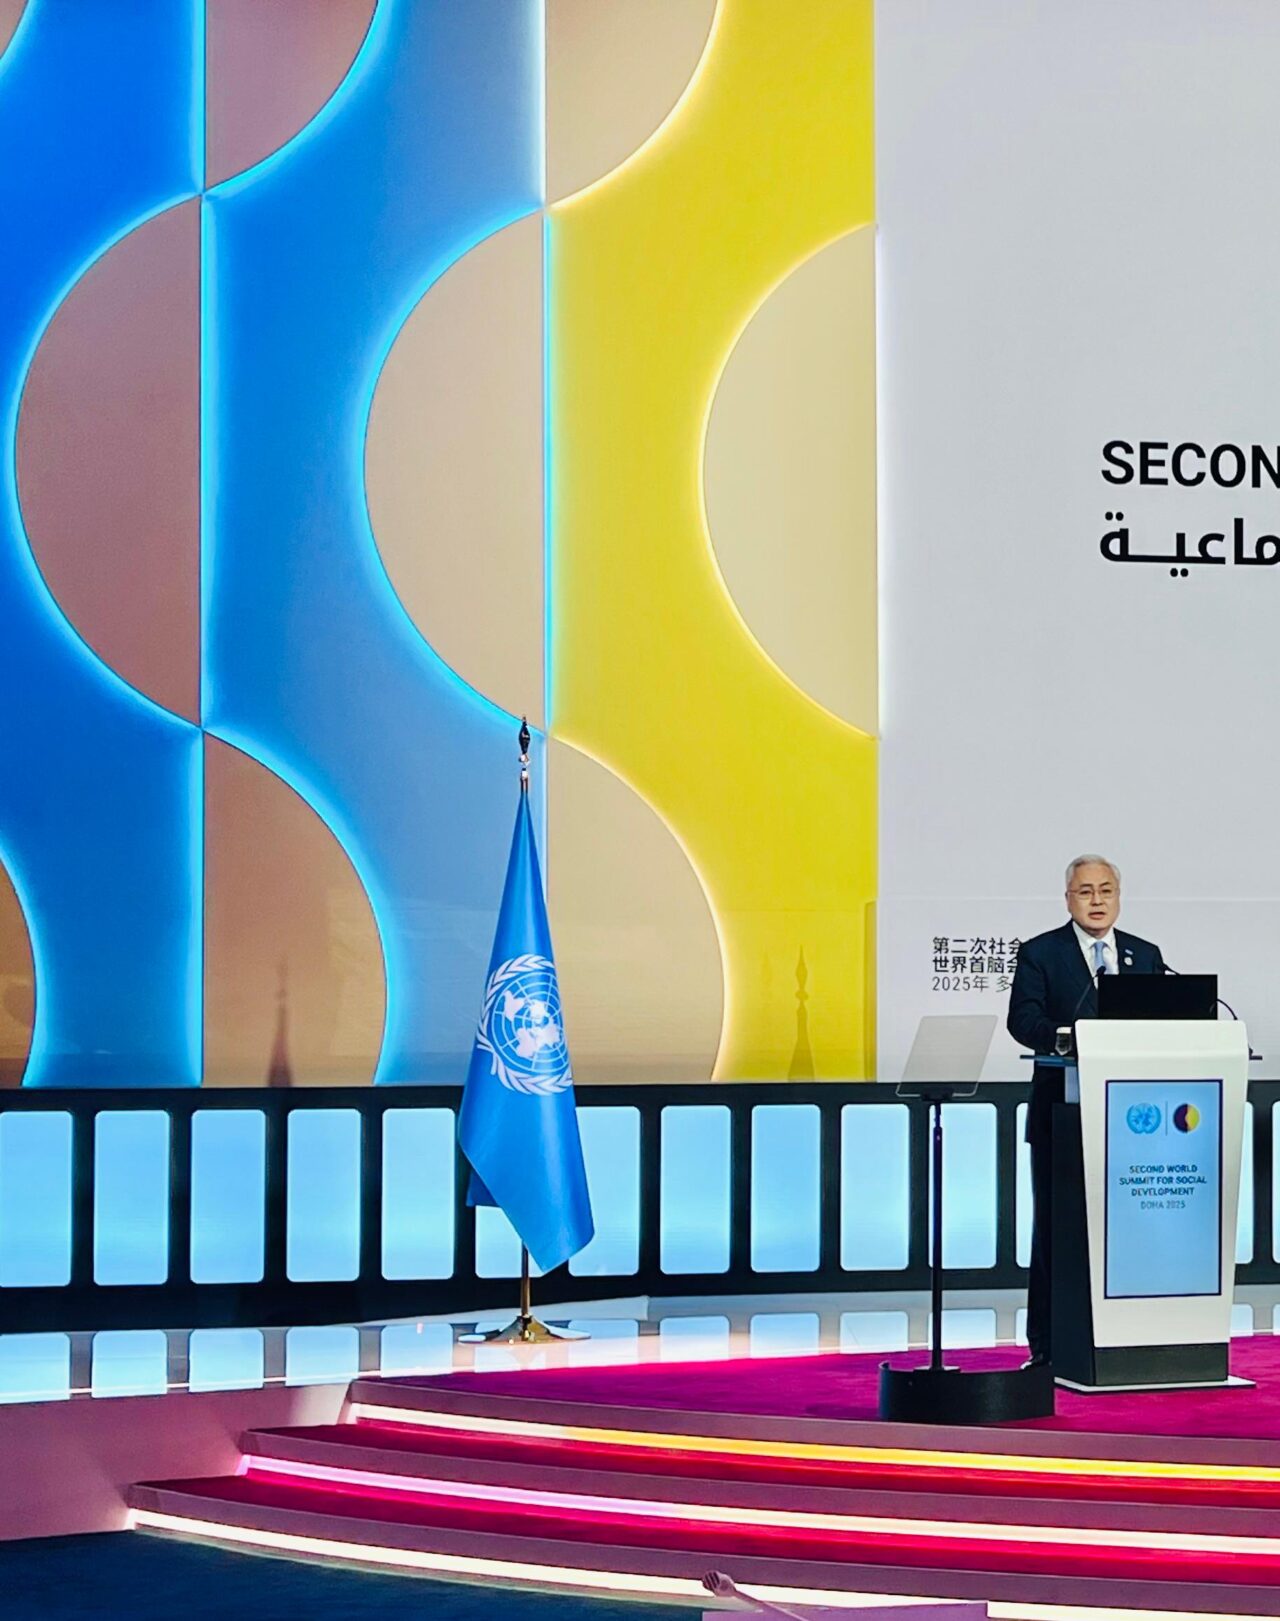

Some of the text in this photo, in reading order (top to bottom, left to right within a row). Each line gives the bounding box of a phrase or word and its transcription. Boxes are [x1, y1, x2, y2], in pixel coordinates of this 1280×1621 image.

[1130, 1165, 1198, 1173] SECOND WORLD
[1119, 1177, 1155, 1185] SUMMIT
[1176, 1176, 1207, 1184] SOCIAL
[1131, 1187, 1194, 1196] DEVELOPMENT
[1141, 1201, 1164, 1209] DOHA
